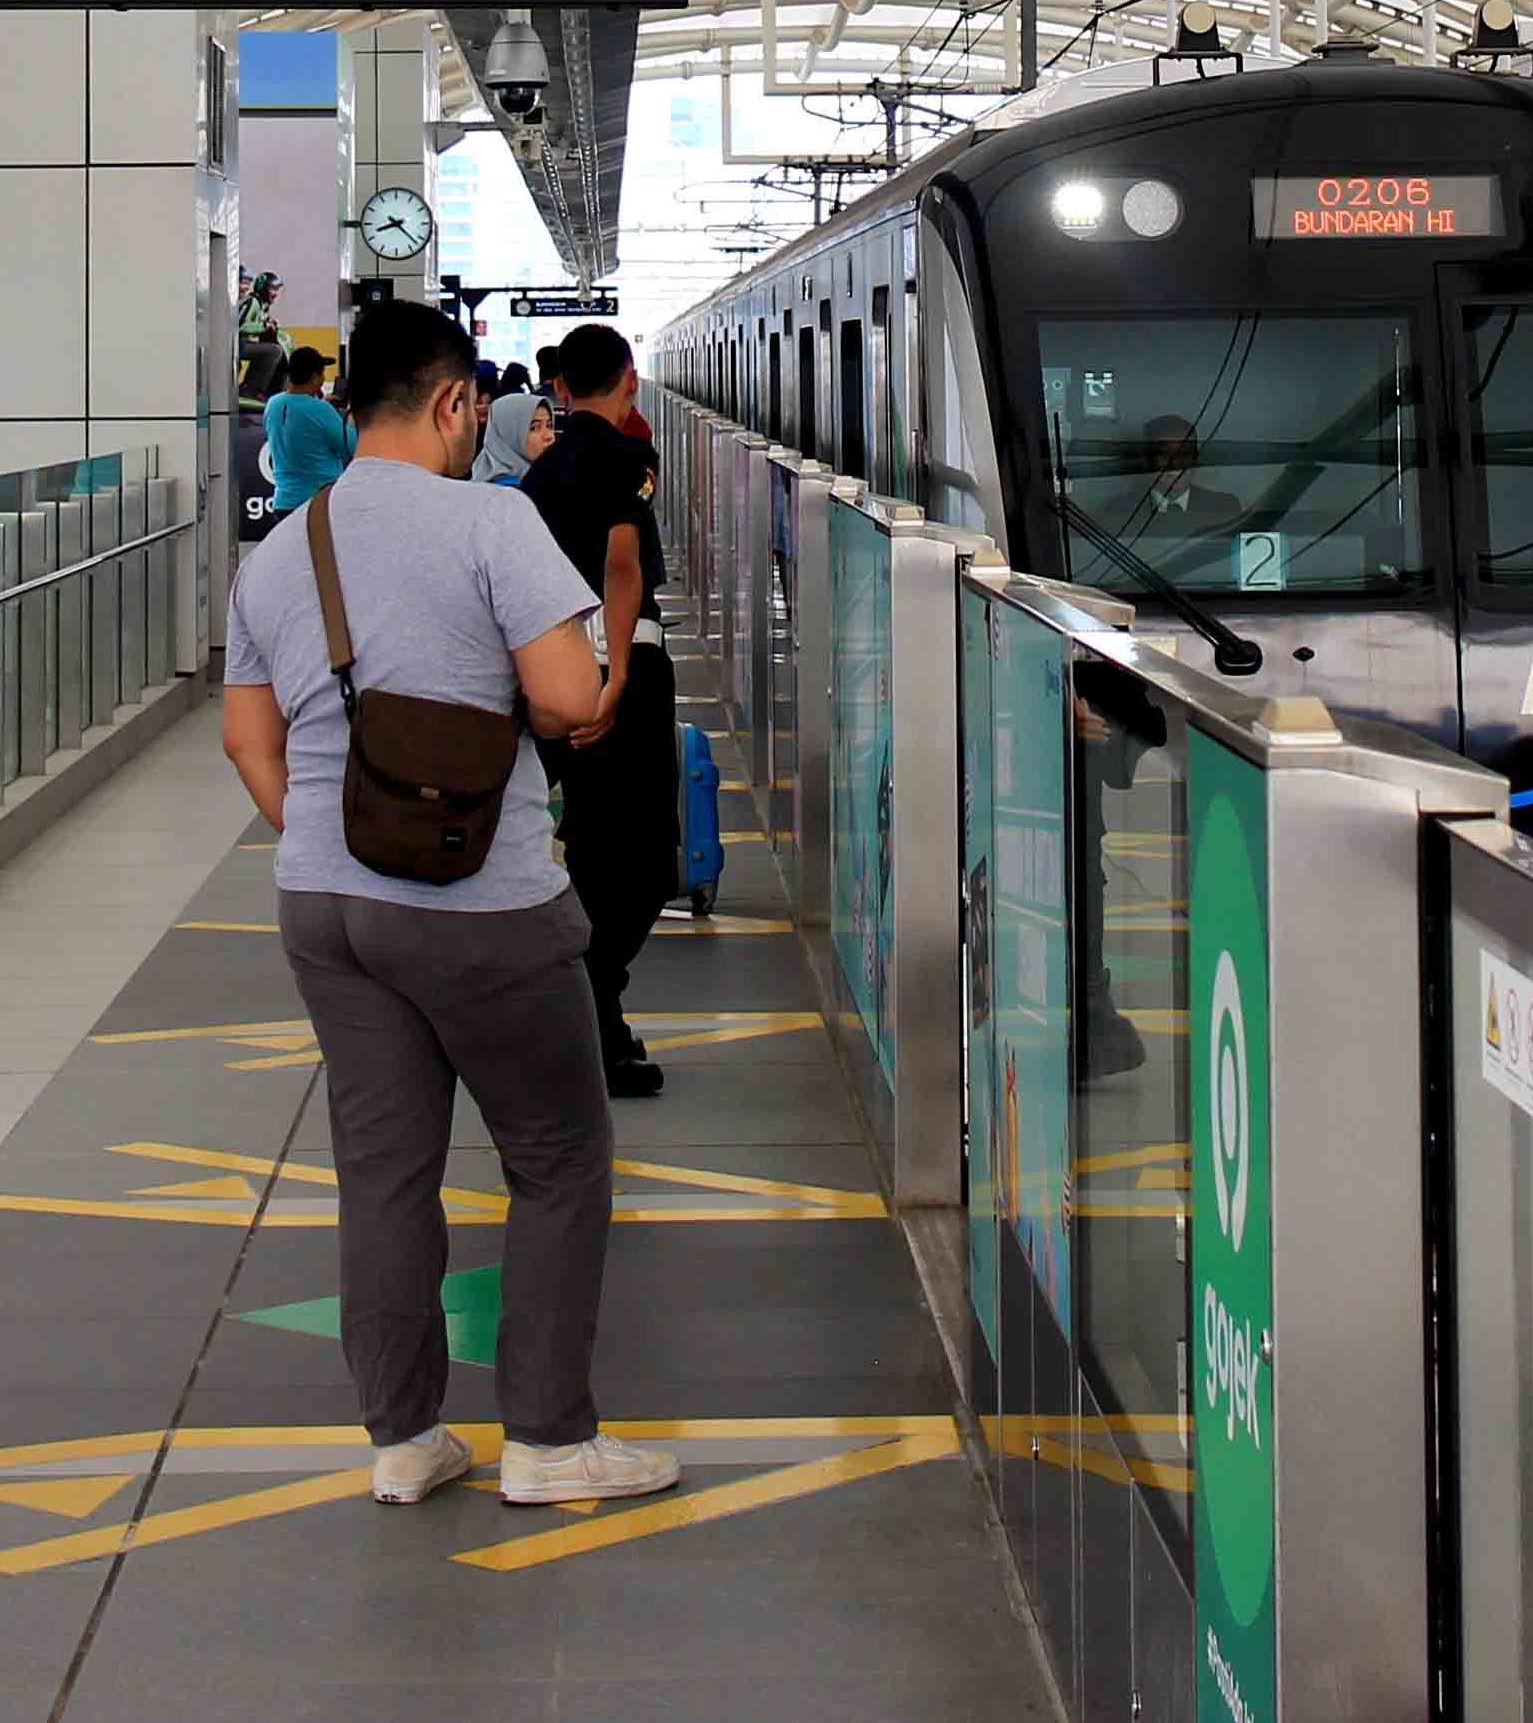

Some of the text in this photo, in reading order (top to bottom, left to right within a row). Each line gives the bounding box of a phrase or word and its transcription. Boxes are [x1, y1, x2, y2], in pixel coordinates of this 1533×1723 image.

[1317, 177, 1432, 207] 0206
[1294, 209, 1456, 234] BUNDARAN HI
[1245, 533, 1279, 588] 2
[1204, 1281, 1261, 1452] gojek
